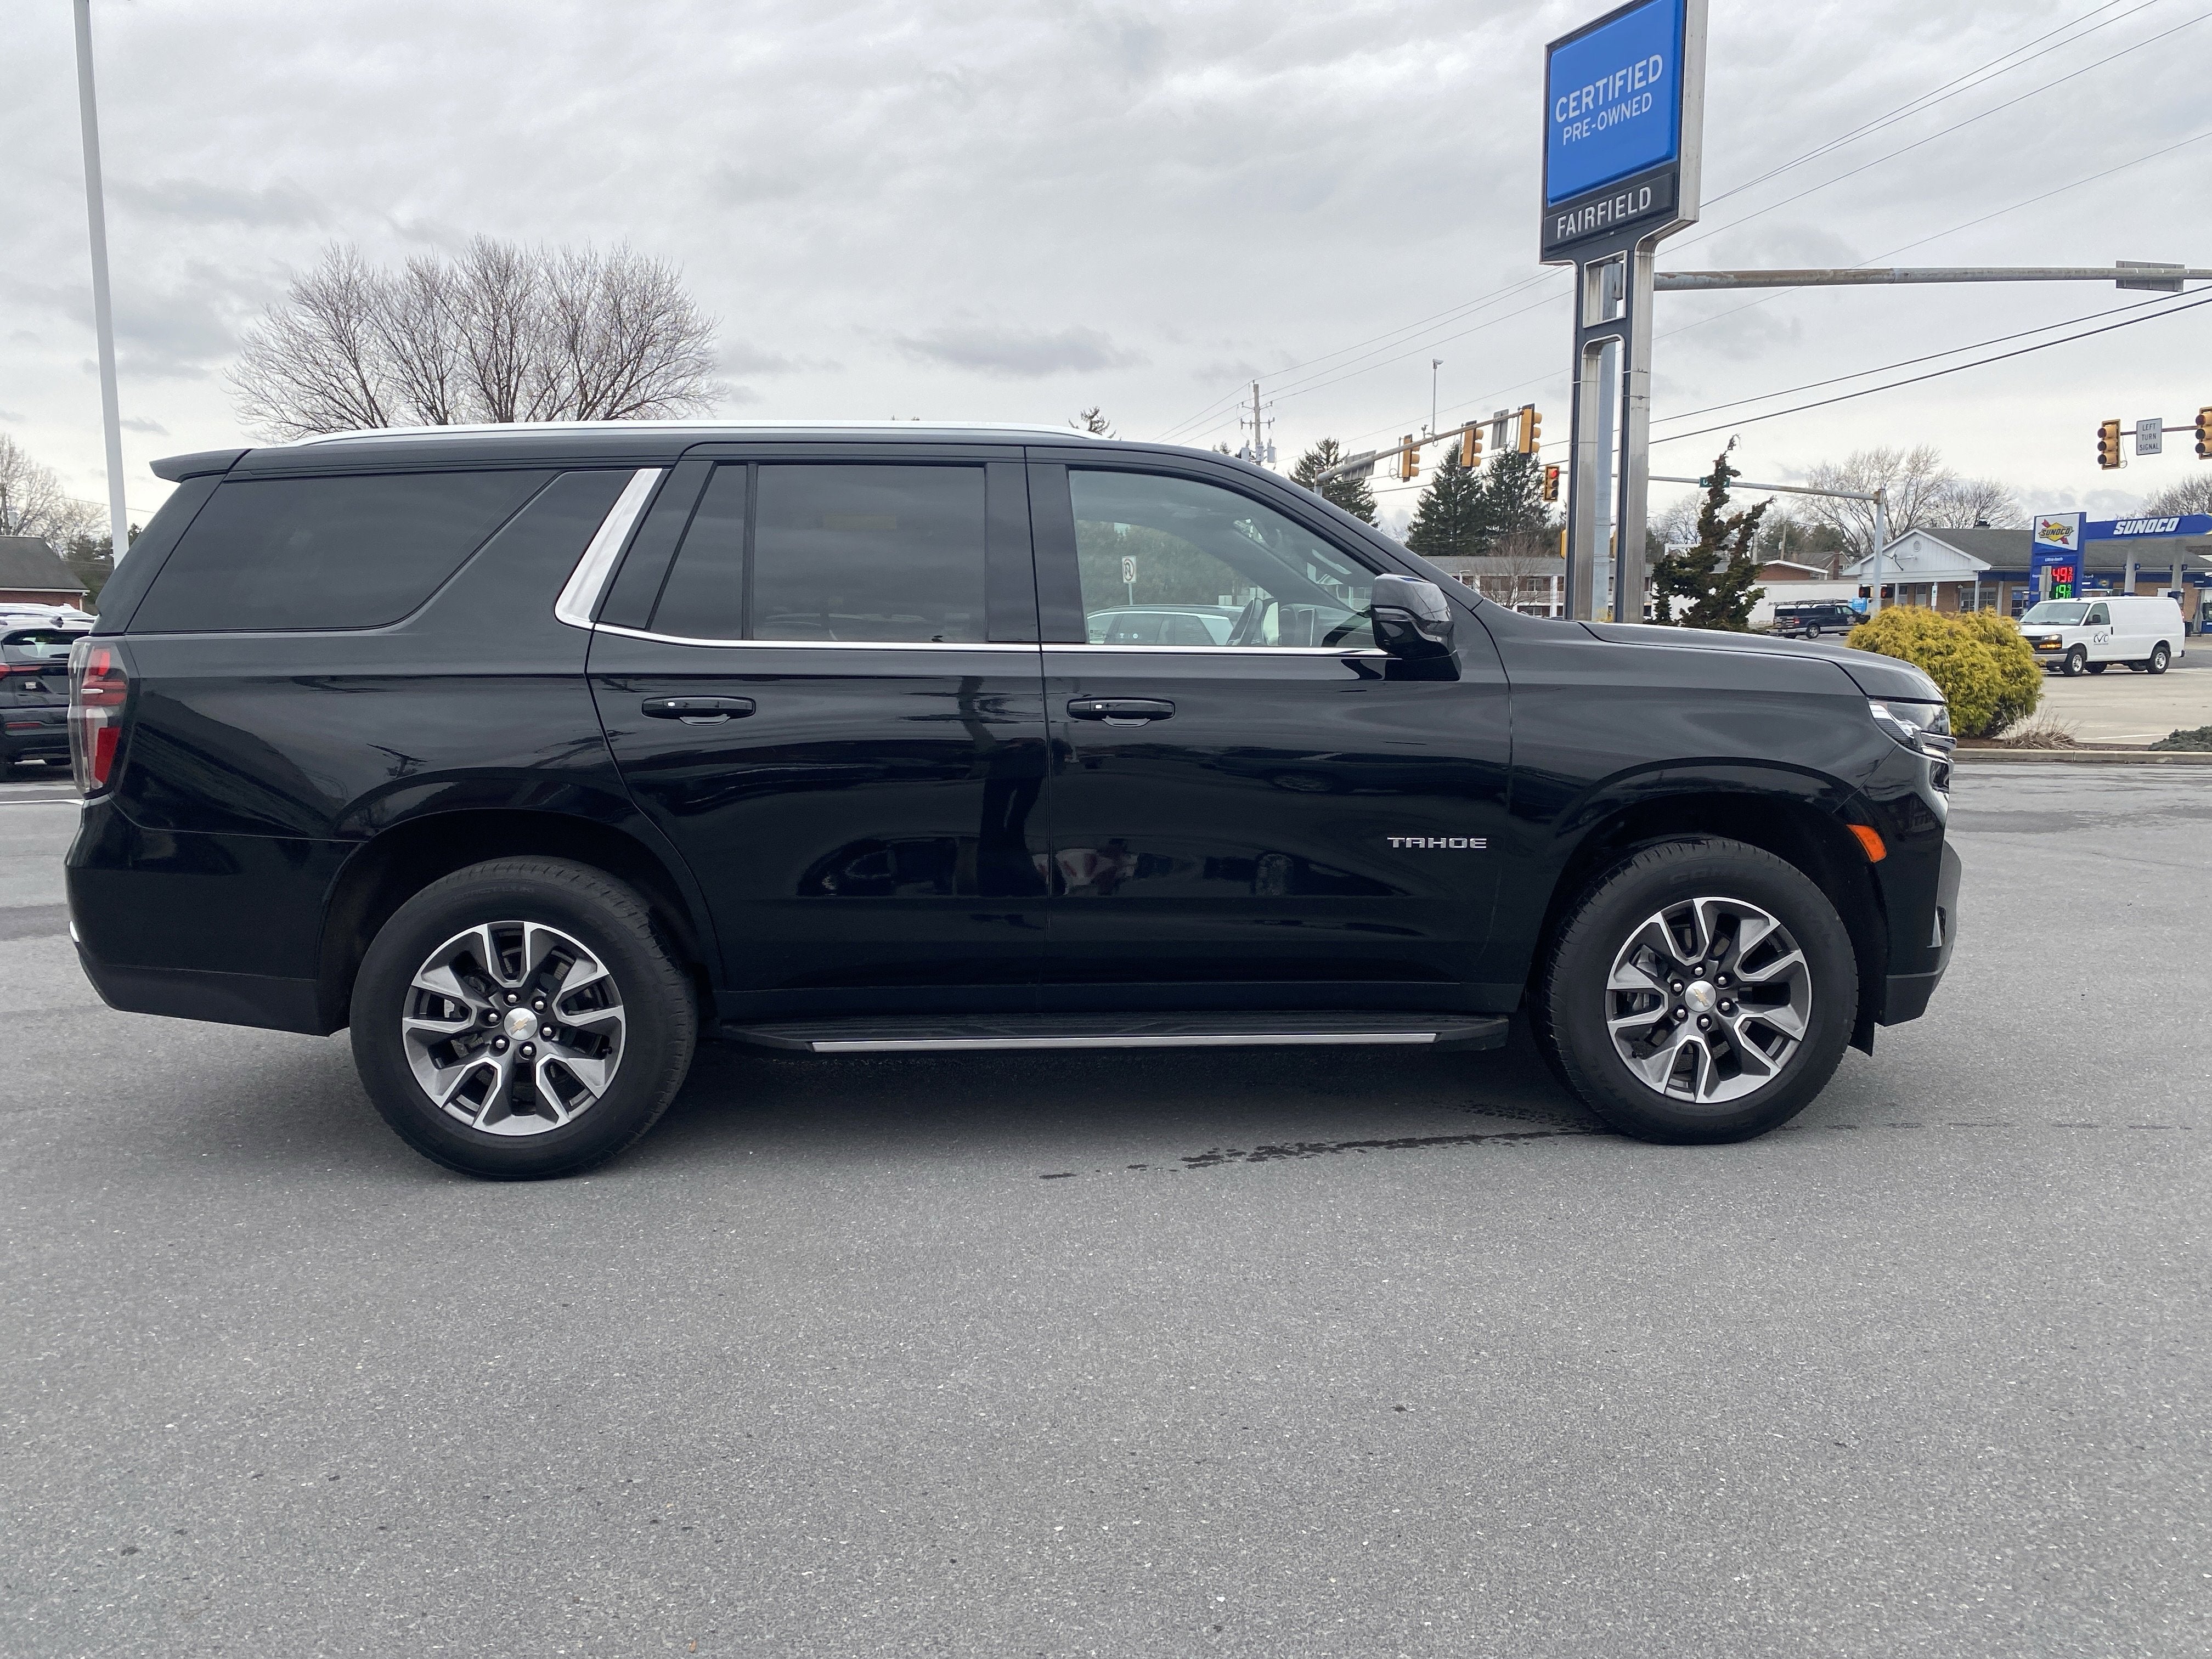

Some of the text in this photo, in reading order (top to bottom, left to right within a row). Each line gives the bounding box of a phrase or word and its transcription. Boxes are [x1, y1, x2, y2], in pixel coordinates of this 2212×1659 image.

[1555, 54, 1663, 123] CERTIFIED
[1563, 92, 1652, 145] PRE-OWNED
[1557, 186, 1651, 239] FAIRFIELD
[2142, 422, 2156, 431] LEFT
[2141, 433, 2157, 441] TURN
[2139, 443, 2160, 451] SIGNAL
[2041, 527, 2071, 537] SUNOCO
[2113, 517, 2180, 535] SUNOCO
[1387, 837, 1487, 849] TAHOE
